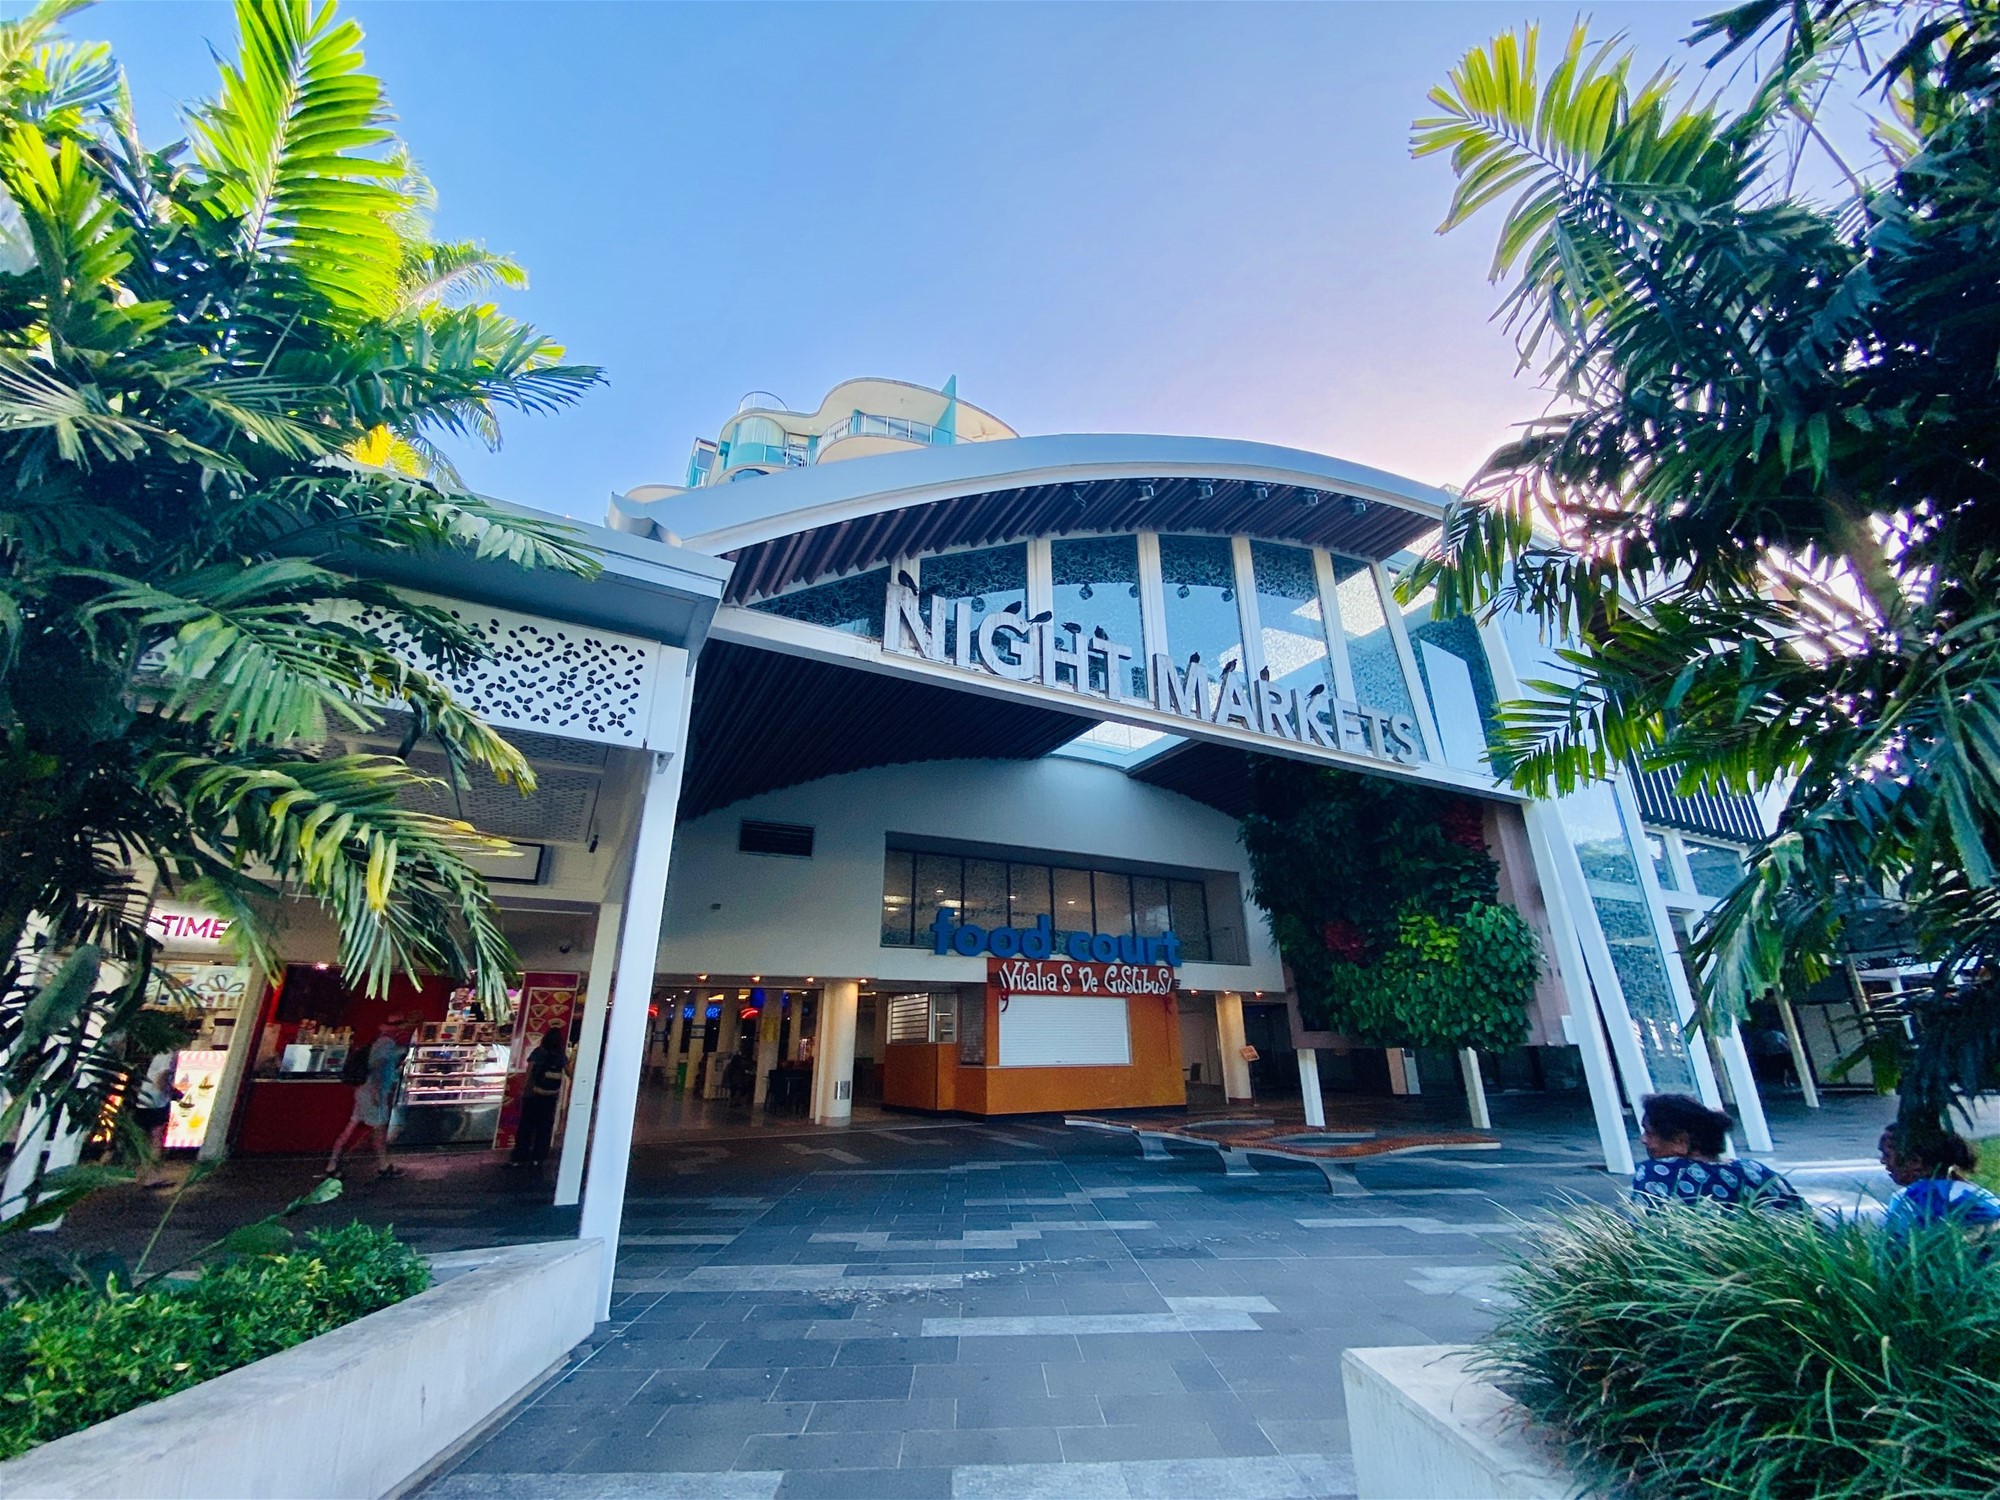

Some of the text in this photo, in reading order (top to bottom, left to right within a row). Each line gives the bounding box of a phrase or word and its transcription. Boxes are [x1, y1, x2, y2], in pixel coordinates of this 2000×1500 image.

[883, 583, 1419, 766] NIGHT MARKETS
[162, 914, 232, 939] TIME
[930, 908, 1182, 967] food court
[1078, 966, 1099, 993] De
